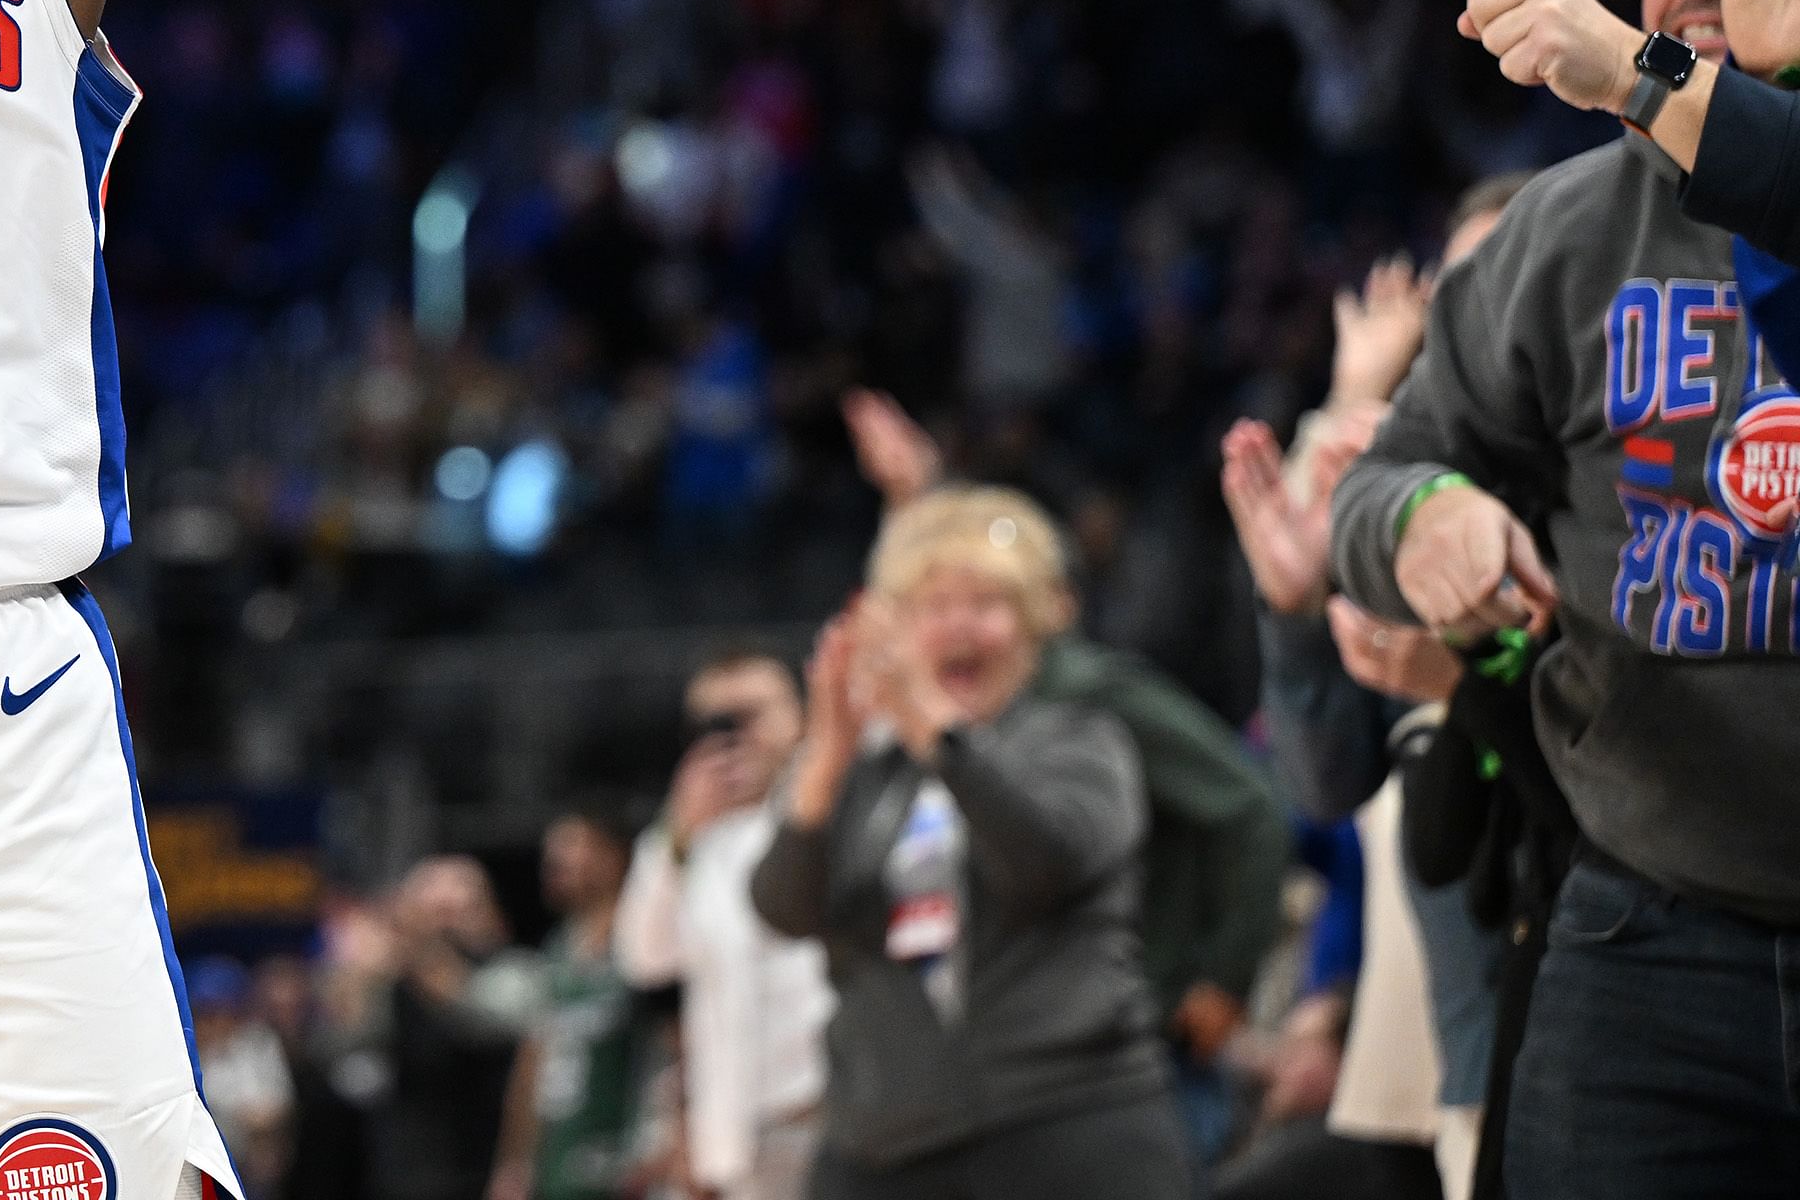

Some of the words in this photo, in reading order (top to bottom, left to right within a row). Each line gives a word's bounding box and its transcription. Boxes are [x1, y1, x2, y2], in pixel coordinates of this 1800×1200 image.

[1741, 469, 1800, 499] PIST
[1610, 483, 1800, 658] PIST
[4, 1161, 85, 1190] DETROIT
